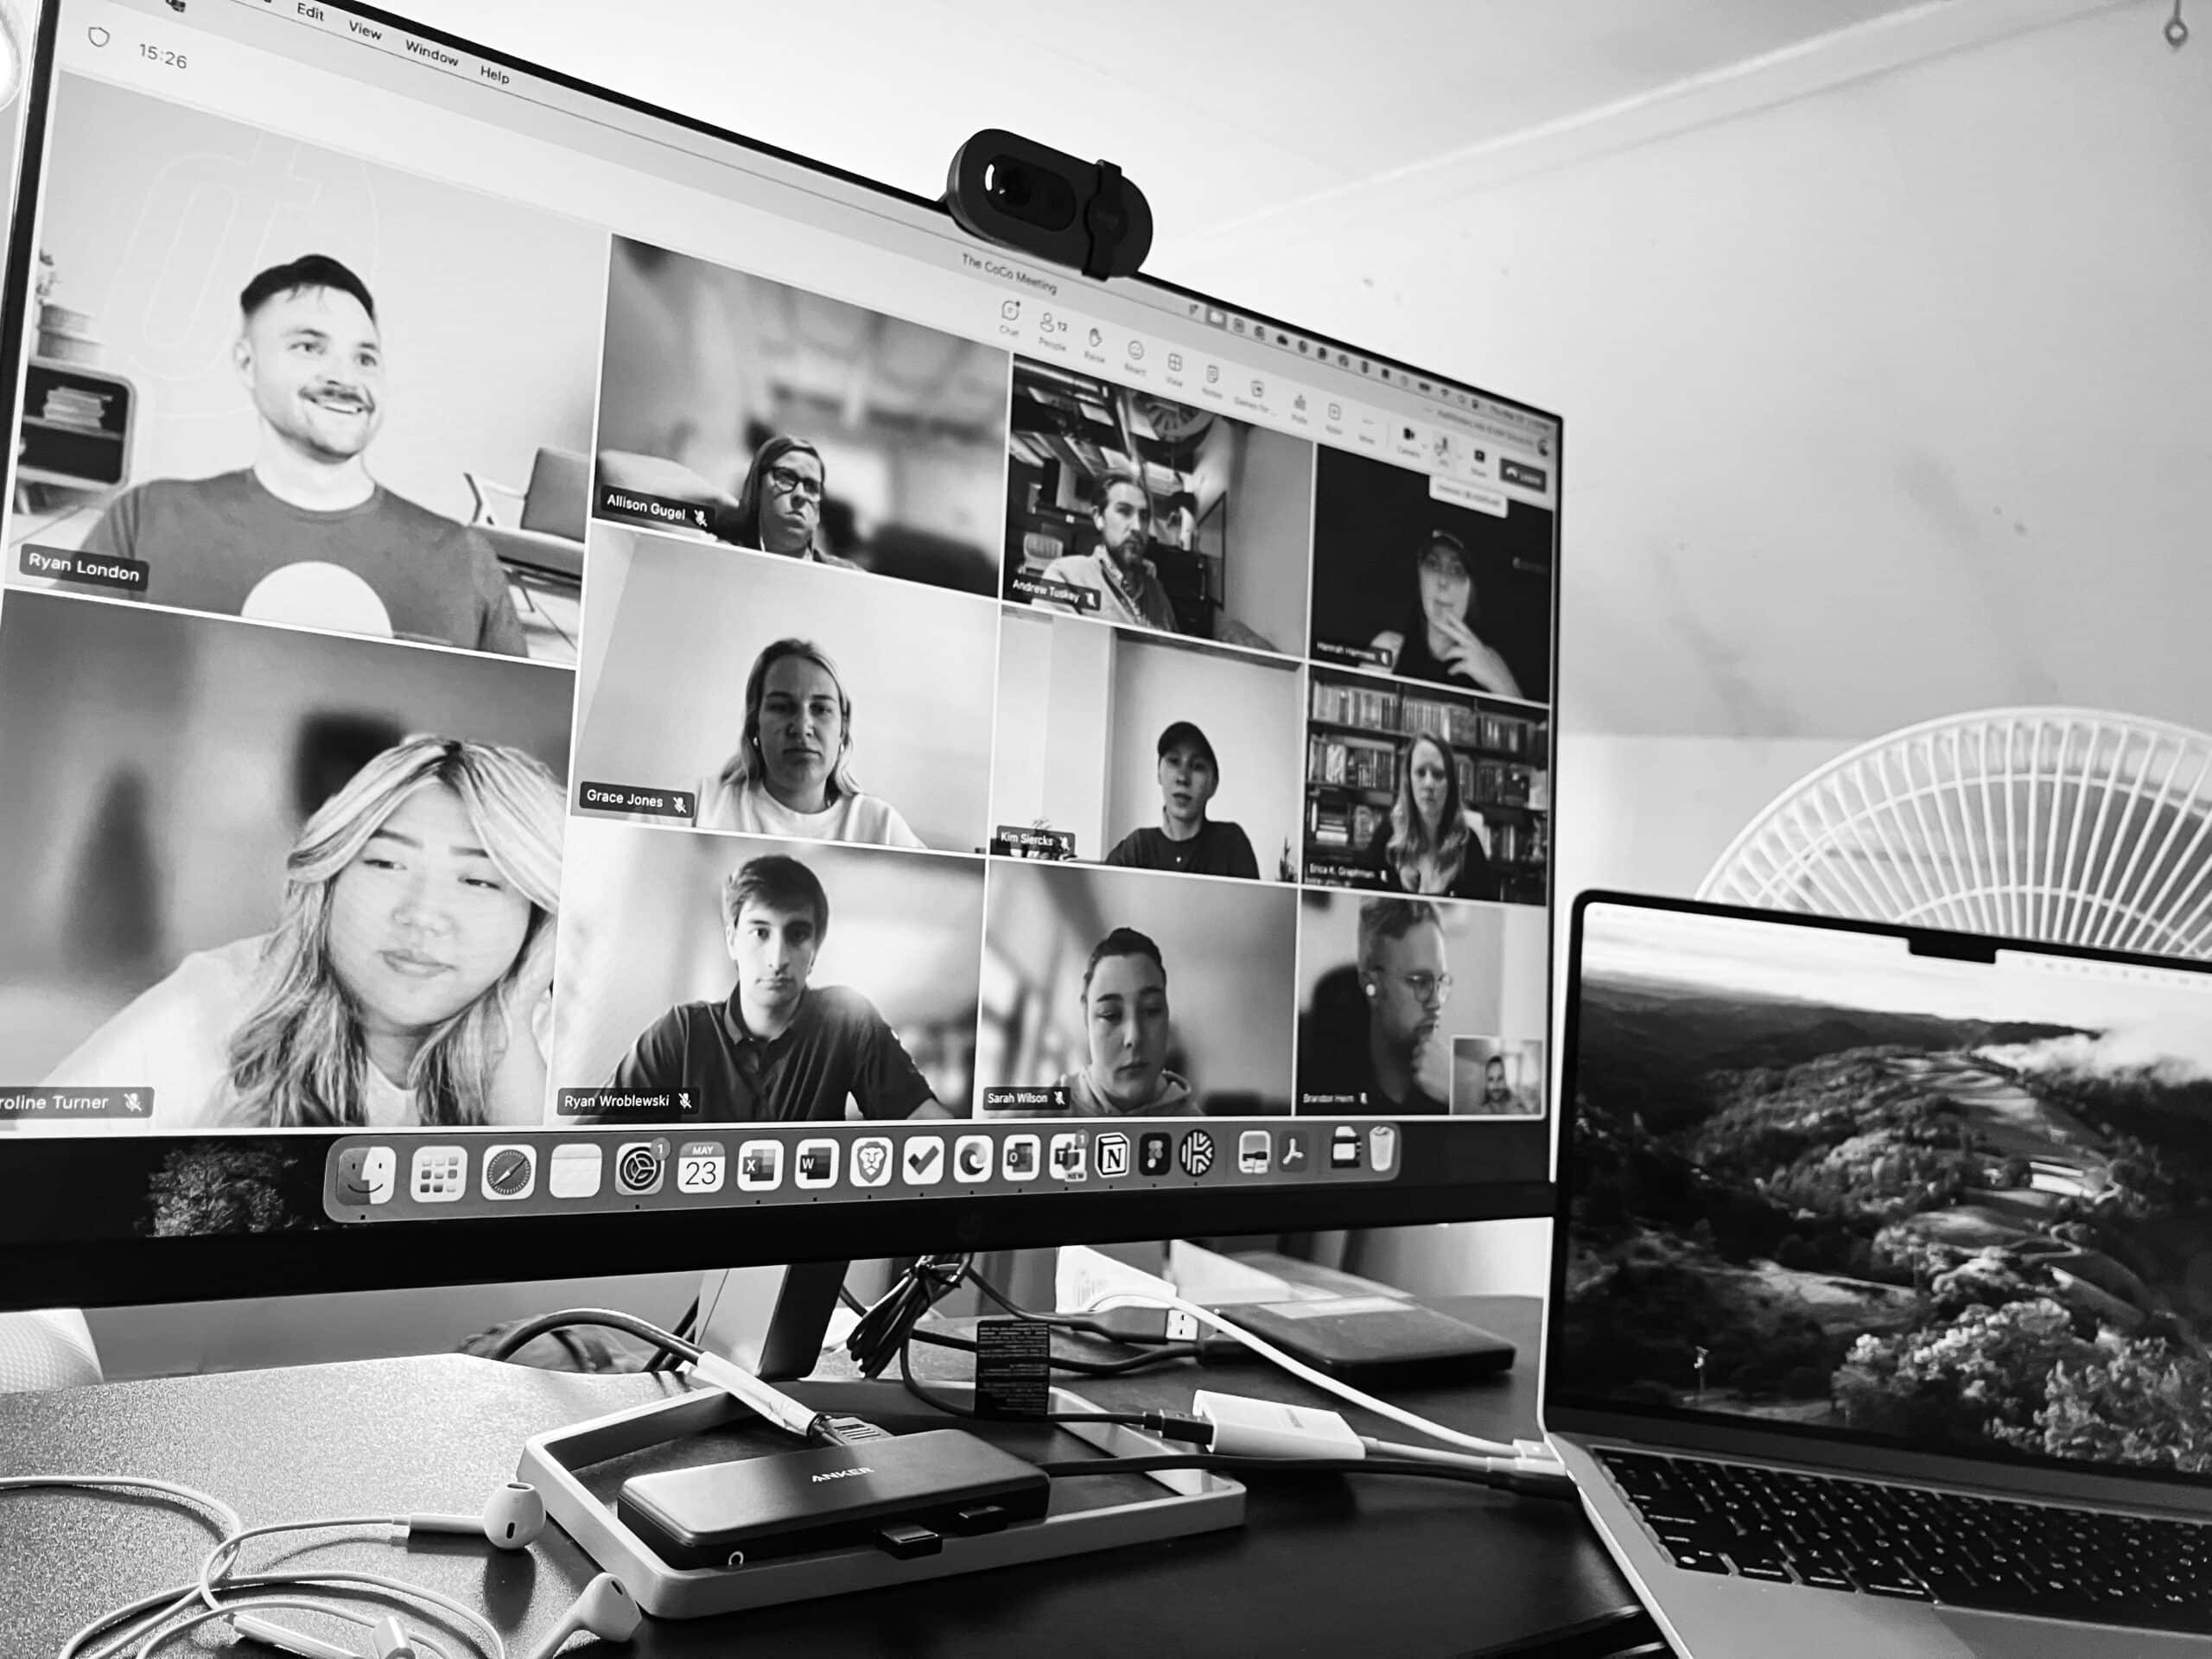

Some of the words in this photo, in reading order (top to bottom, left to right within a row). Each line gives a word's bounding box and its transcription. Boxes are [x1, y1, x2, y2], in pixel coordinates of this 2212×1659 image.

[297, 3, 325, 22] Edit
[349, 20, 382, 41] View
[138, 43, 188, 69] 15:26
[405, 40, 459, 67] Window
[480, 65, 510, 85] Help
[963, 253, 982, 269] The
[985, 262, 1014, 279] CoCo
[1016, 271, 1058, 296] Meeting
[607, 494, 648, 512] Allison
[651, 503, 685, 520] Gugel
[29, 552, 71, 571] Ryan
[77, 562, 139, 582] London
[587, 789, 624, 804] Grace
[627, 793, 664, 808] Jones
[1001, 831, 1019, 843] Kim
[52, 1095, 109, 1110] Turner
[564, 1095, 595, 1109] Ryan
[600, 1094, 670, 1107] Wroblewski
[988, 1092, 1015, 1103] Sarah
[1017, 1092, 1048, 1103] Wilson
[657, 1143, 664, 1154] 1
[692, 1146, 714, 1155] MAY
[1106, 1147, 1122, 1168] N
[685, 1161, 716, 1185] 23
[746, 1160, 756, 1172] X
[802, 1158, 815, 1170] W
[812, 1467, 874, 1483] ANKER
